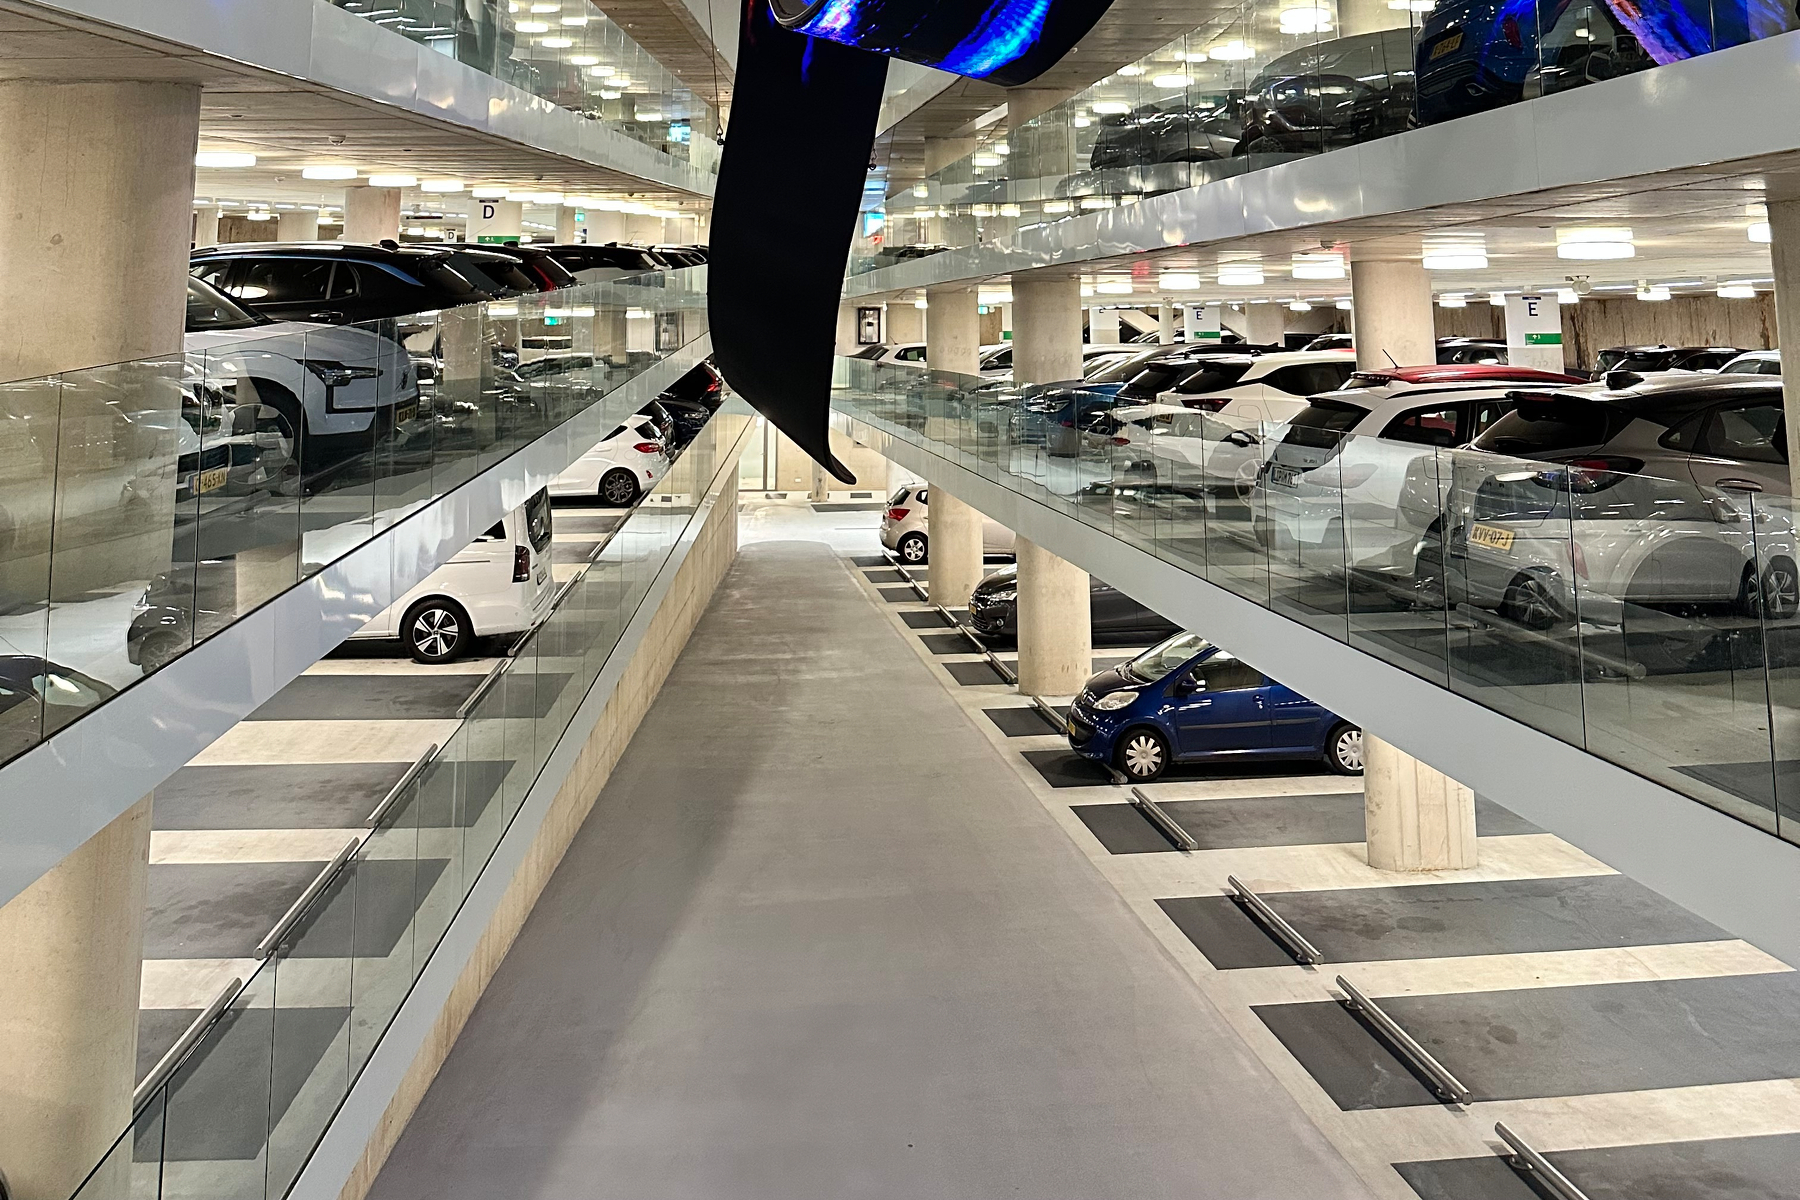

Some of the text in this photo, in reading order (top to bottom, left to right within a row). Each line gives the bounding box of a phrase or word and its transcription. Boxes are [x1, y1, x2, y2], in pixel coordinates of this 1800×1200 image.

[483, 204, 495, 219] D
[448, 232, 455, 240] D
[1196, 310, 1203, 320] E
[1528, 302, 1538, 317] E
[1472, 525, 1510, 547] KVV-07-J
